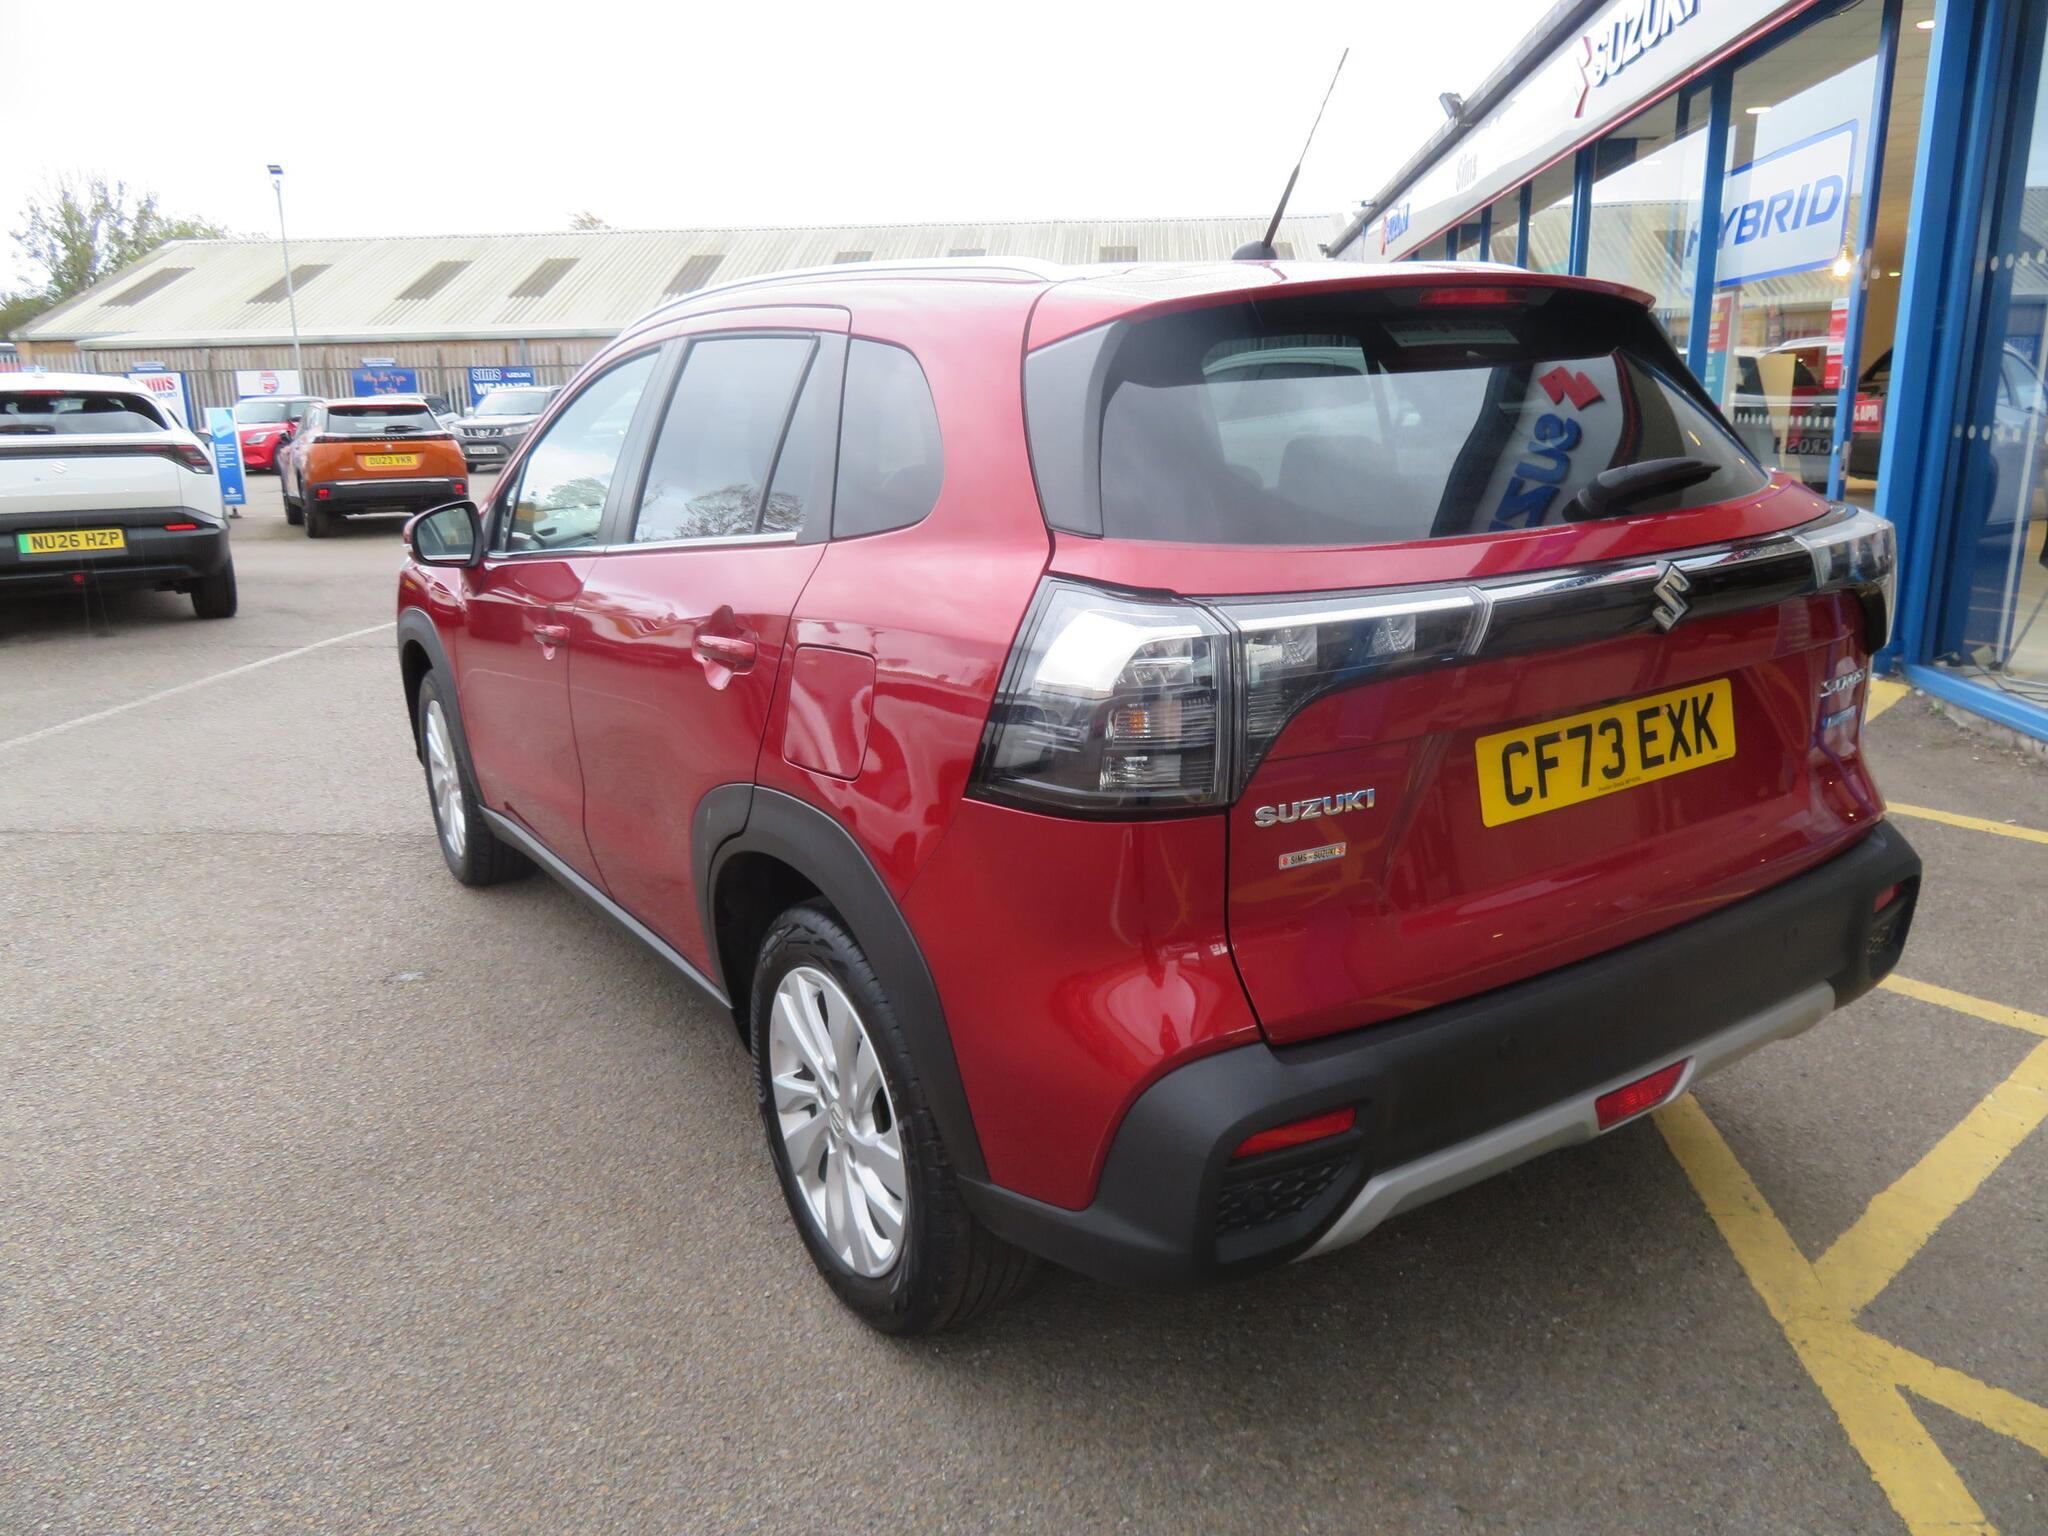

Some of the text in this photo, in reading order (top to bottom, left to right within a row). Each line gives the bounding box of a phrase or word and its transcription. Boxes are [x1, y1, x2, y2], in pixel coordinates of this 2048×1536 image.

[31, 532, 120, 550] NU26 HZP
[1502, 692, 1718, 807] CF73 EXK
[1254, 788, 1375, 828] SUZUKI
[1290, 853, 1307, 865] SIMS
[1313, 847, 1336, 859] SUZUKI
